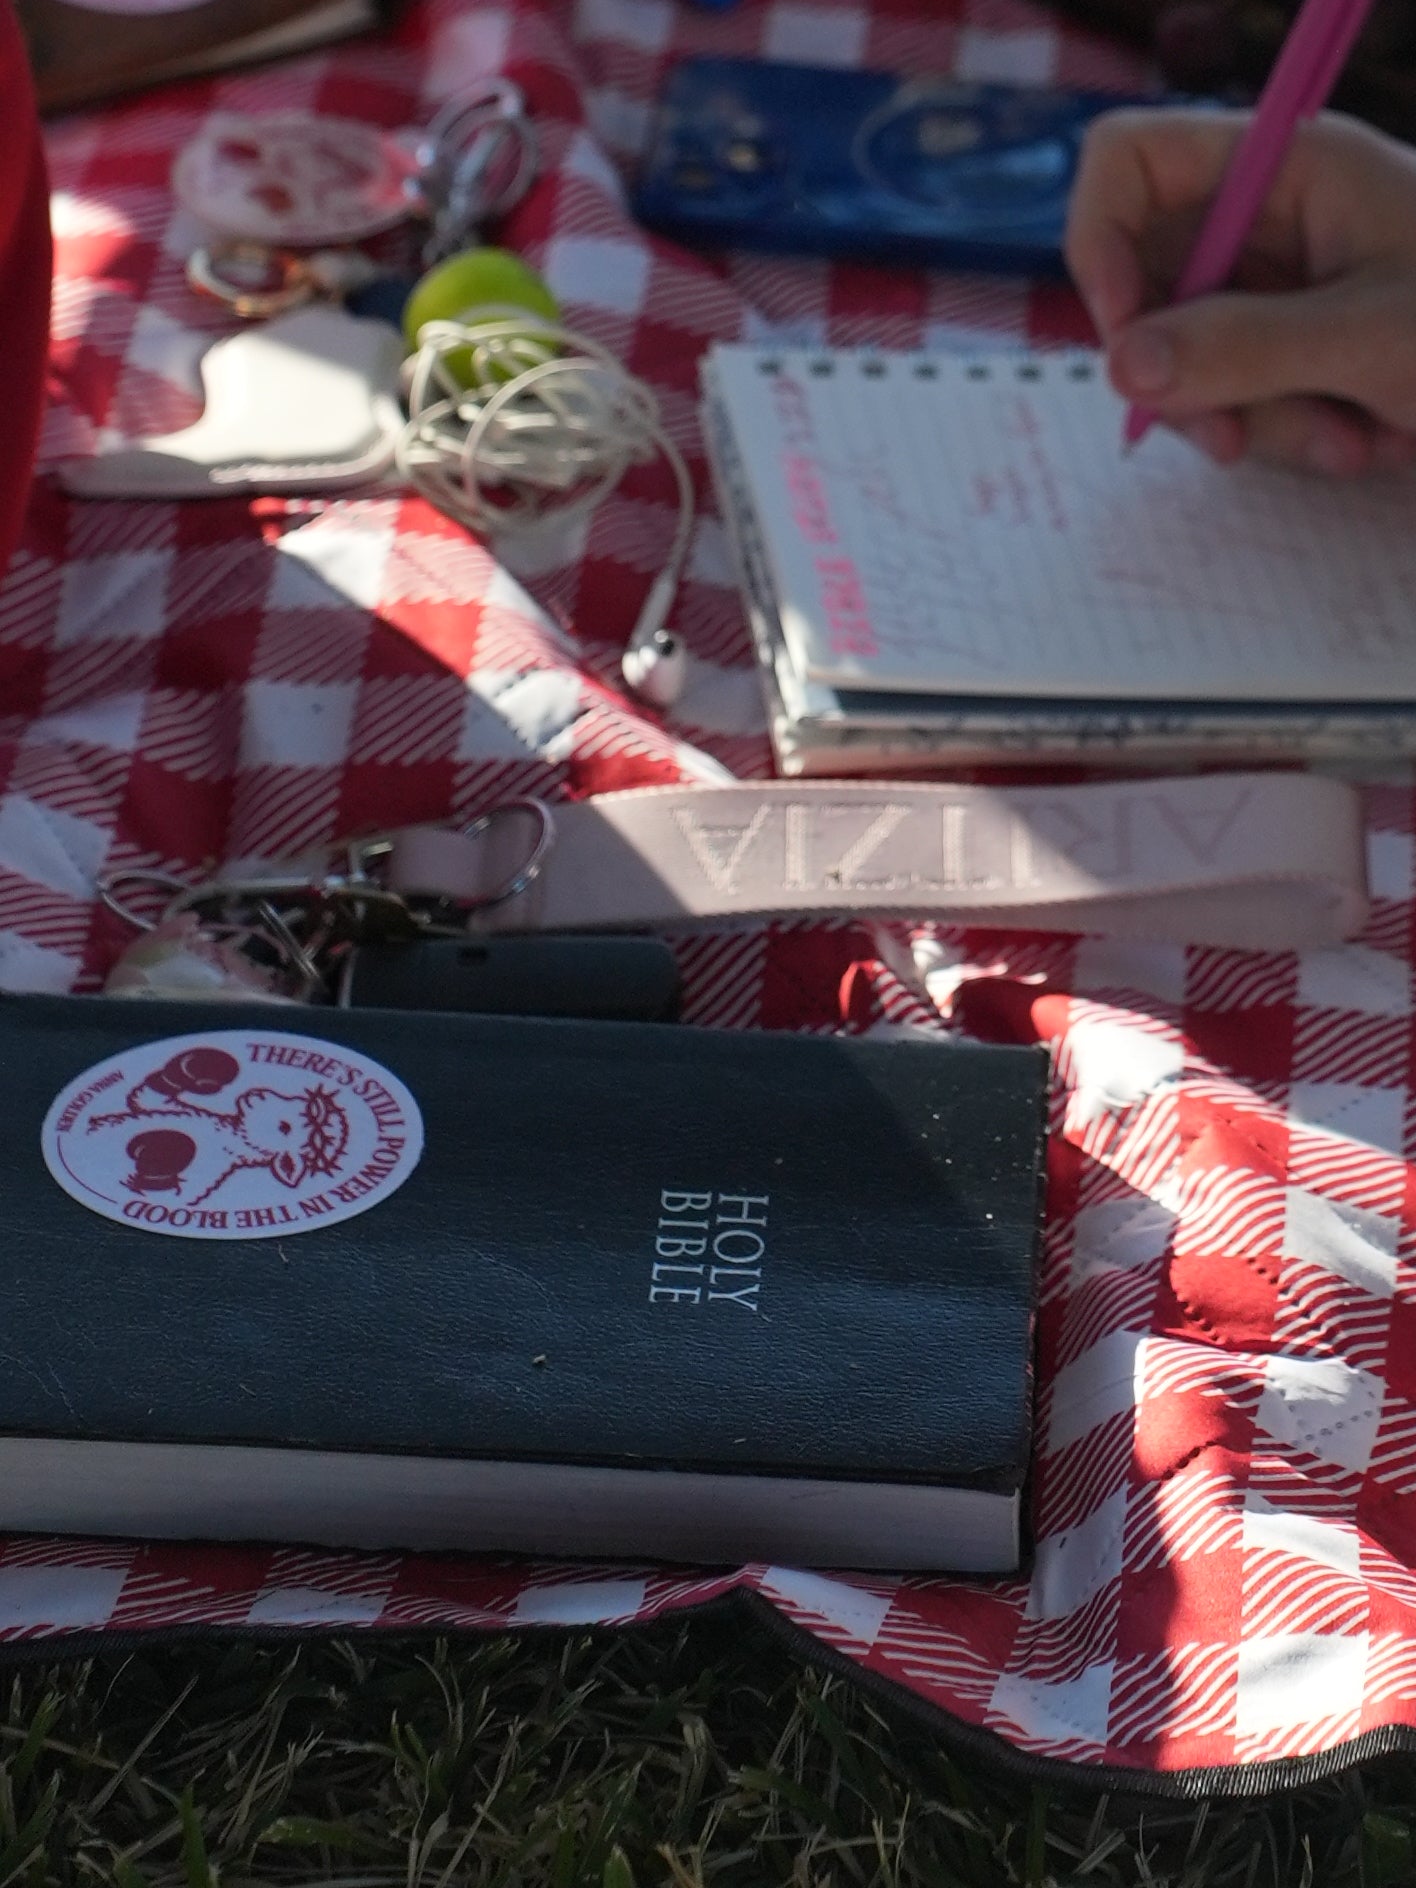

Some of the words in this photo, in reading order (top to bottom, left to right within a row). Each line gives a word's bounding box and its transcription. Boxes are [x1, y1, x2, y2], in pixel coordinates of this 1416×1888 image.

[672, 791, 1253, 894] ARITZIA
[246, 1042, 363, 1085] THERE'S
[351, 1078, 406, 1132] STILL
[329, 1135, 406, 1203] POWER
[122, 1199, 229, 1229] BLOOD
[235, 1204, 299, 1229] THE
[298, 1193, 335, 1217] IN
[648, 1189, 713, 1305] BIBLE
[707, 1192, 770, 1312] HOLY
